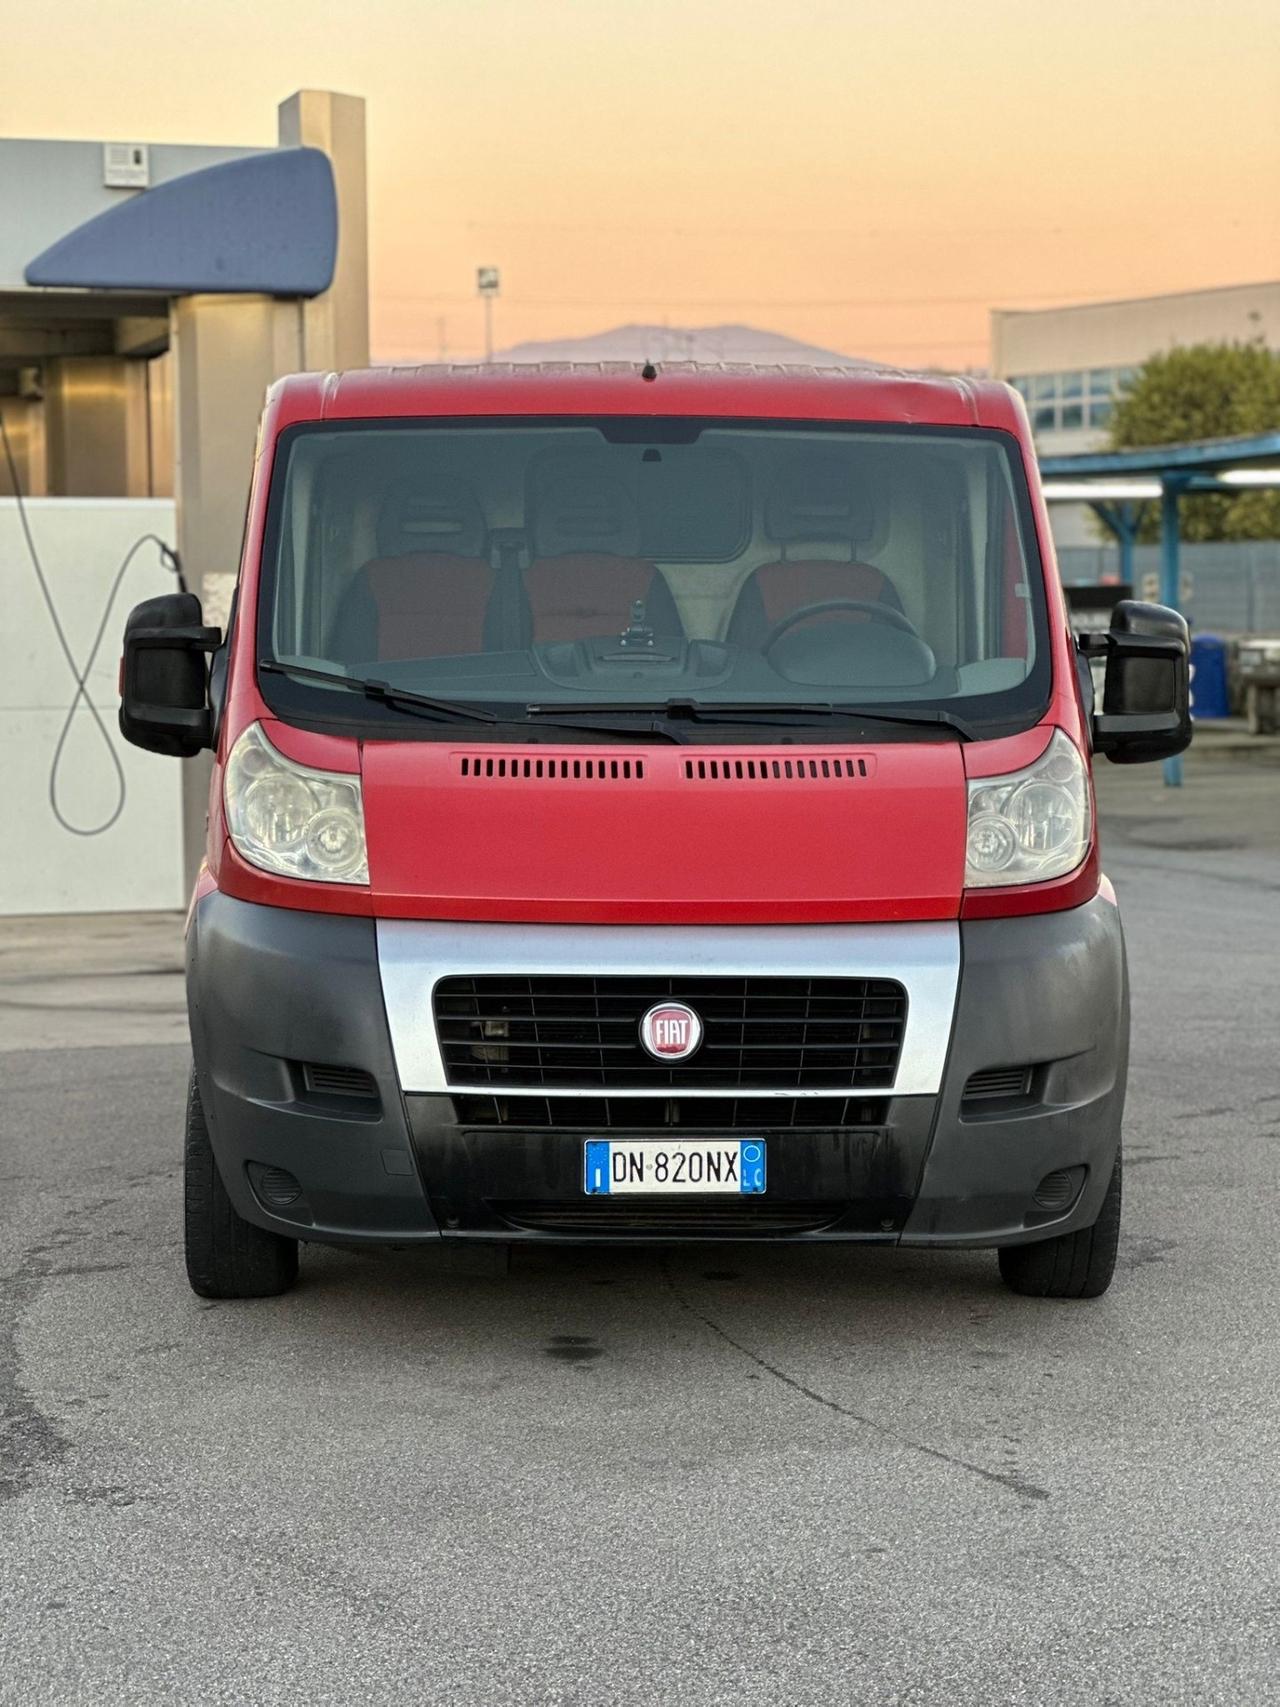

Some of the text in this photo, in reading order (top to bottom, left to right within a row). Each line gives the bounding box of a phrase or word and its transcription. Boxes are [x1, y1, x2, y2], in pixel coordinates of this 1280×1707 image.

[656, 1019, 689, 1045] FIAT
[613, 1151, 738, 1182] DN 820NX
